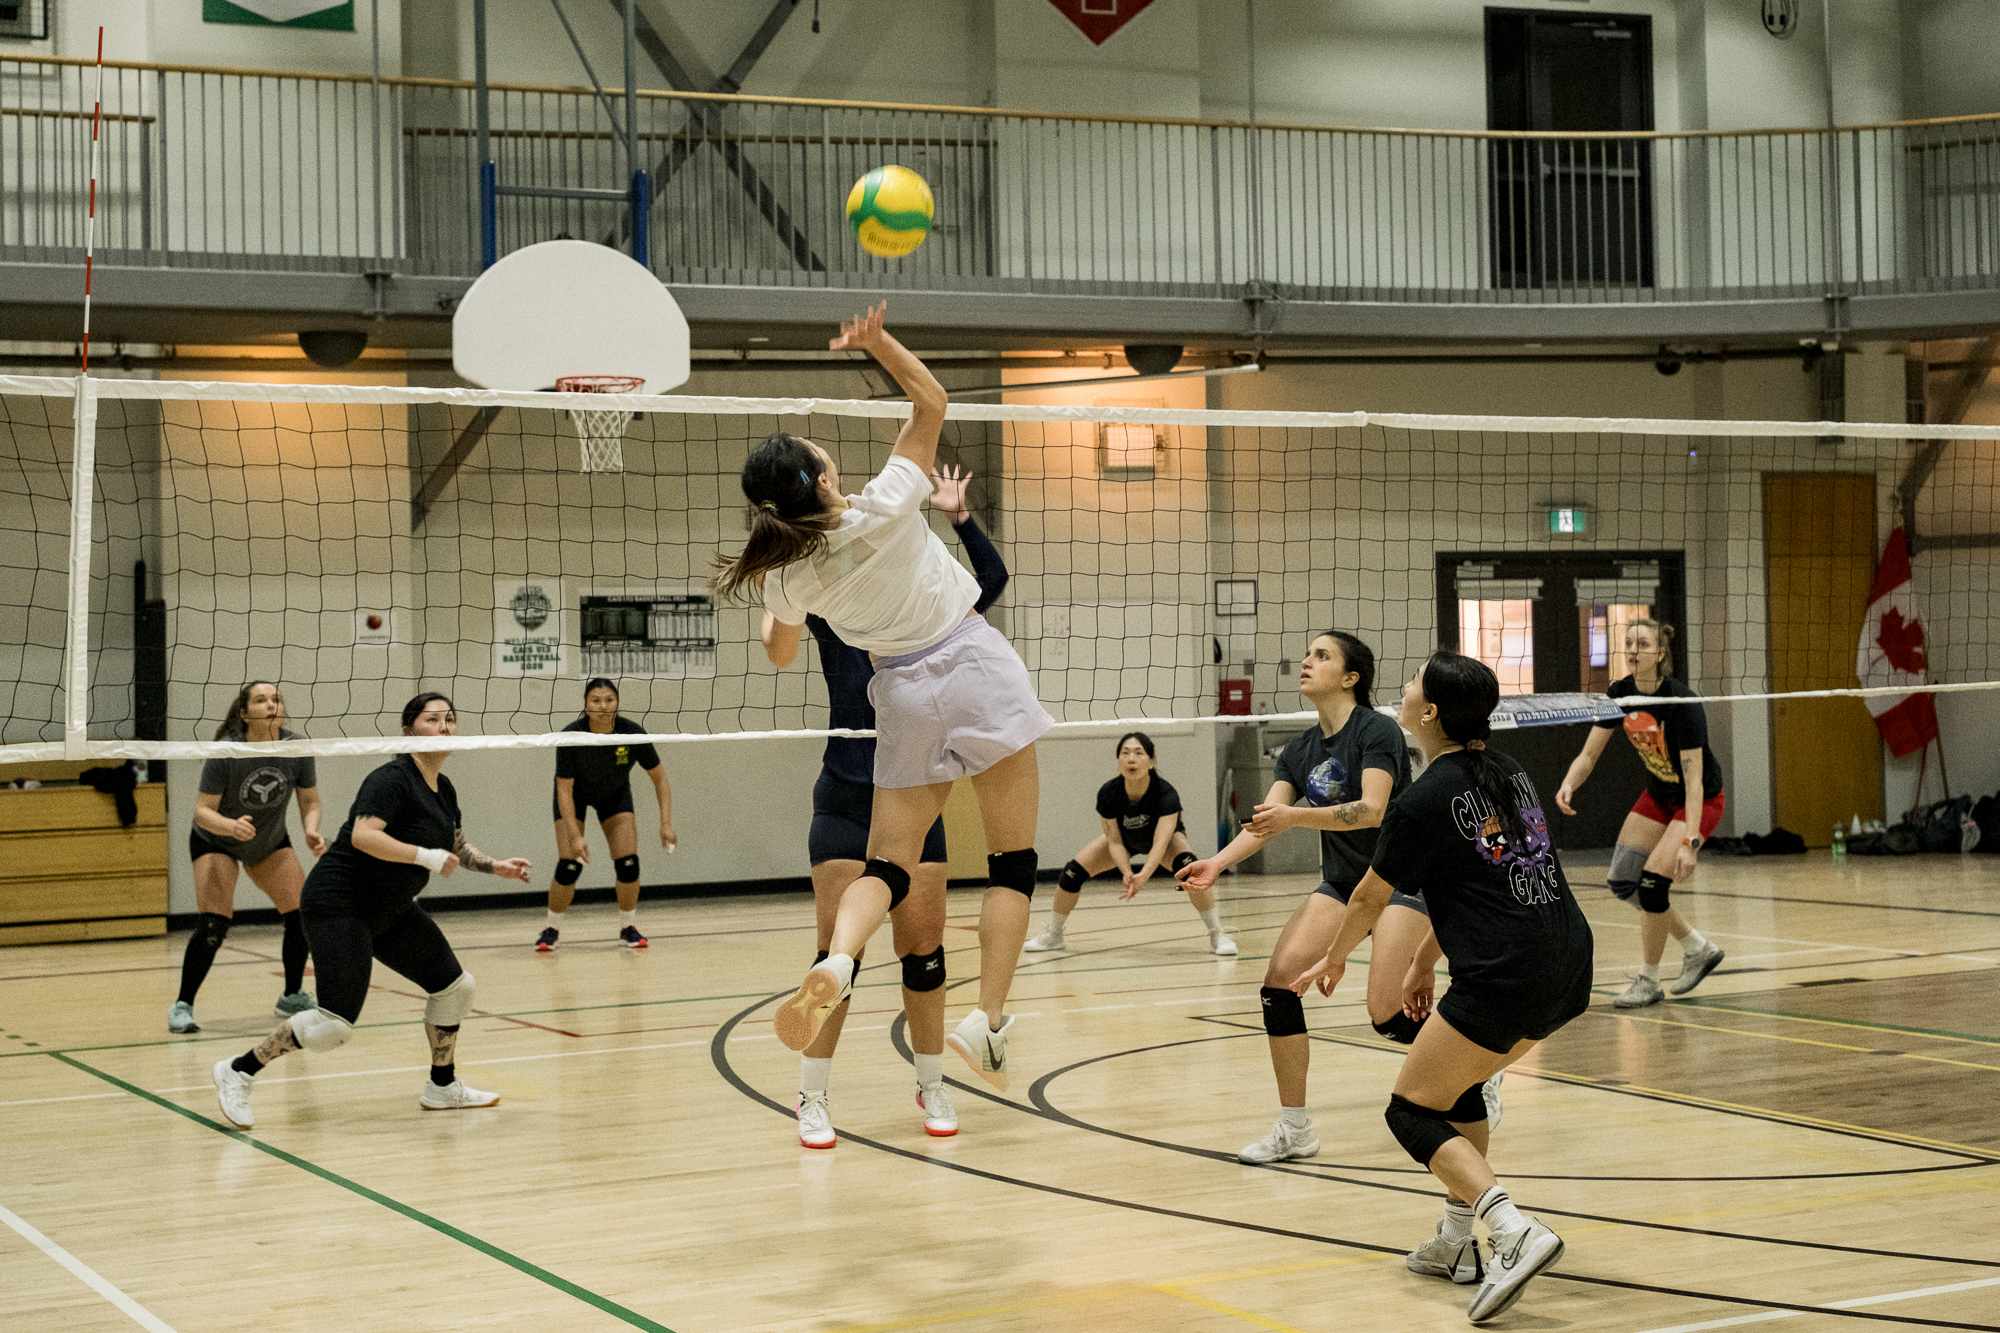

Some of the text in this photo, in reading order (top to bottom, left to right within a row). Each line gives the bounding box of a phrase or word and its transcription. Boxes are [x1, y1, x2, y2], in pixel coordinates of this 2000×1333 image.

[504, 637, 559, 646] WELCOME TO
[503, 654, 561, 662] BASKETBALL
[1509, 853, 1561, 905] GANG
